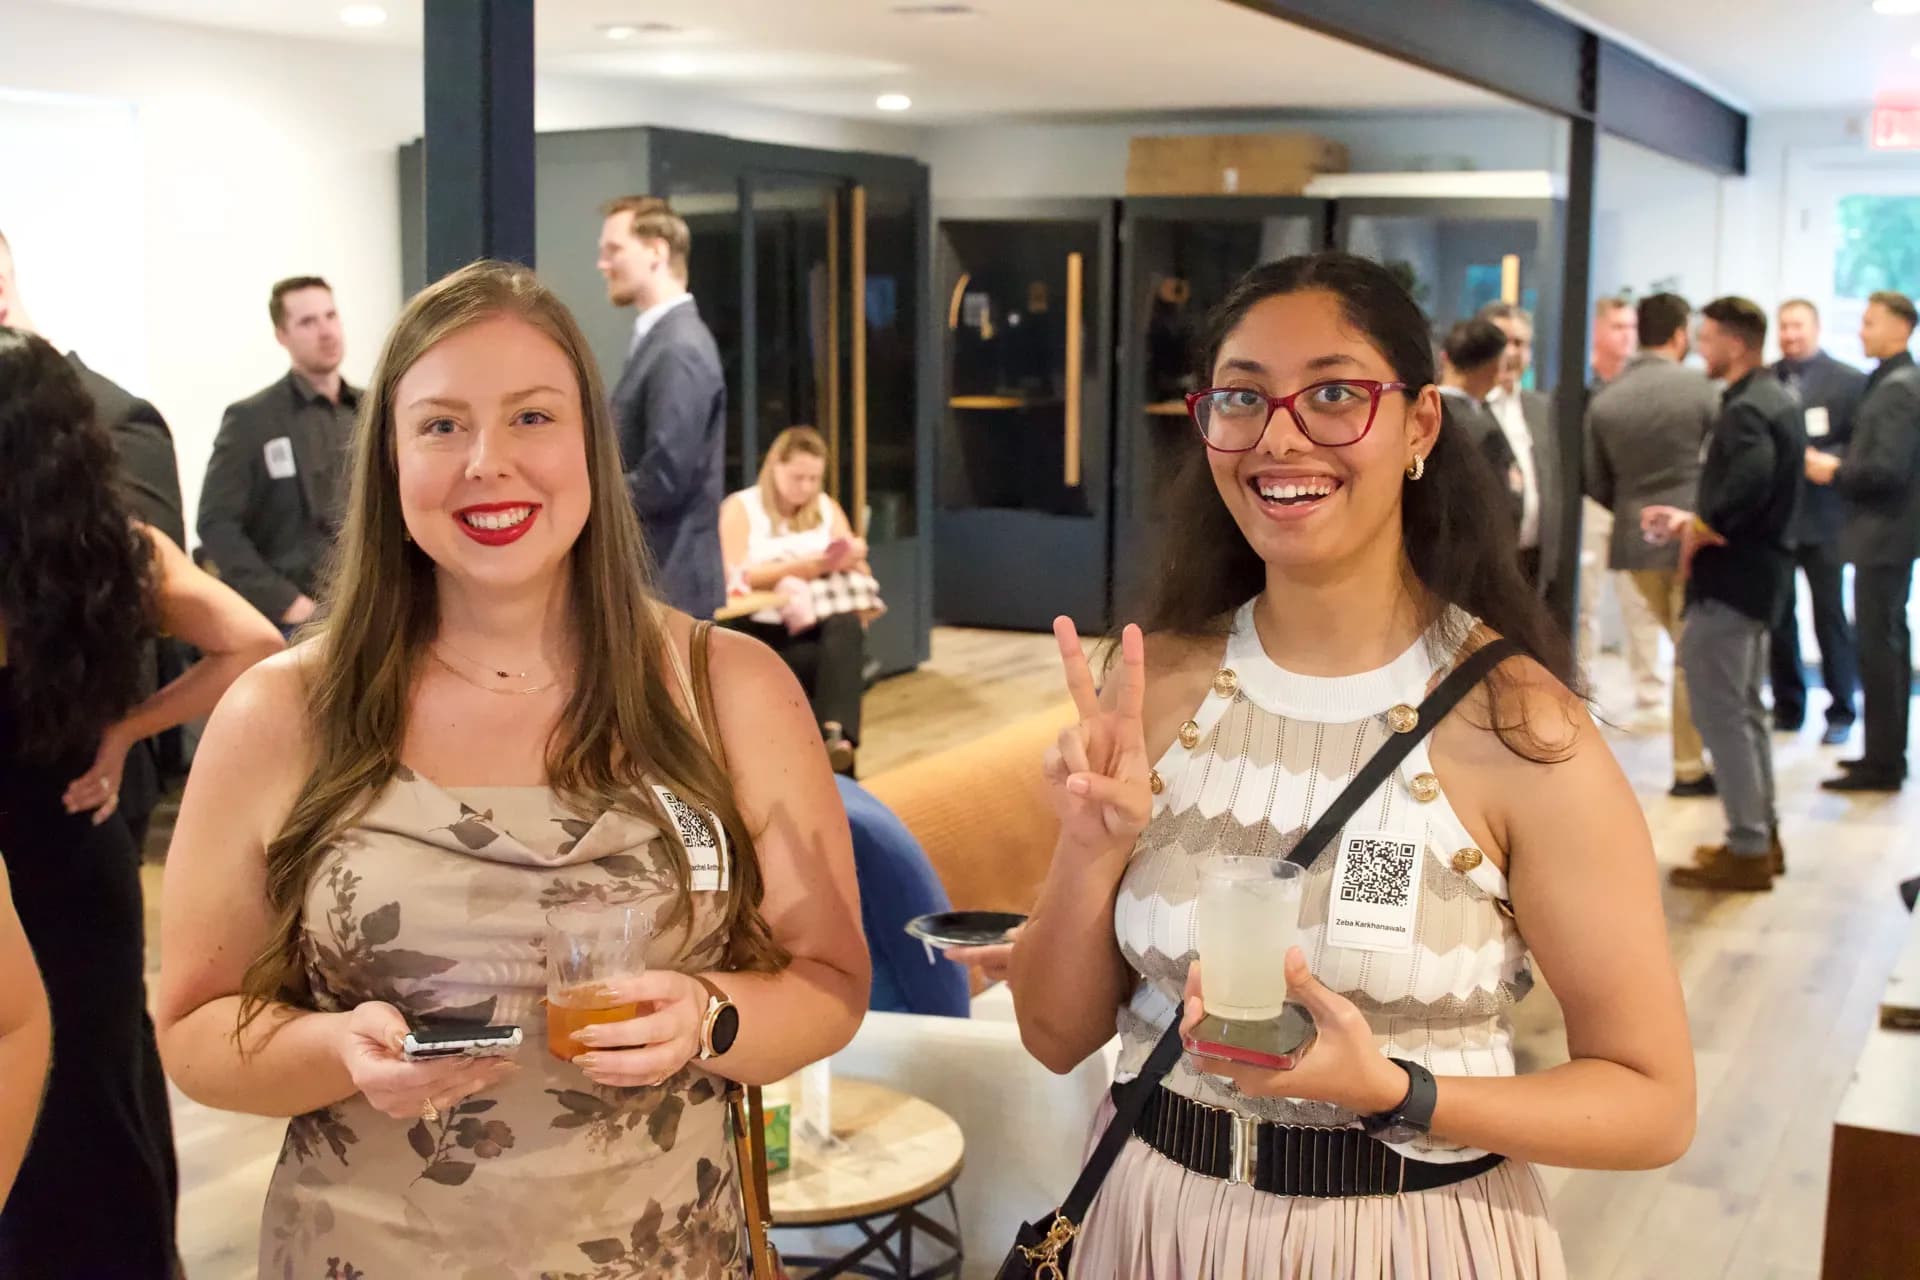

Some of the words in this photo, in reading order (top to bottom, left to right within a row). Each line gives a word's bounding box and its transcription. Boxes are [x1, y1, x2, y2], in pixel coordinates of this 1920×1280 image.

[690, 863, 706, 871] achel
[1336, 918, 1354, 927] Zeba
[1355, 920, 1406, 933] Karkhanawala
